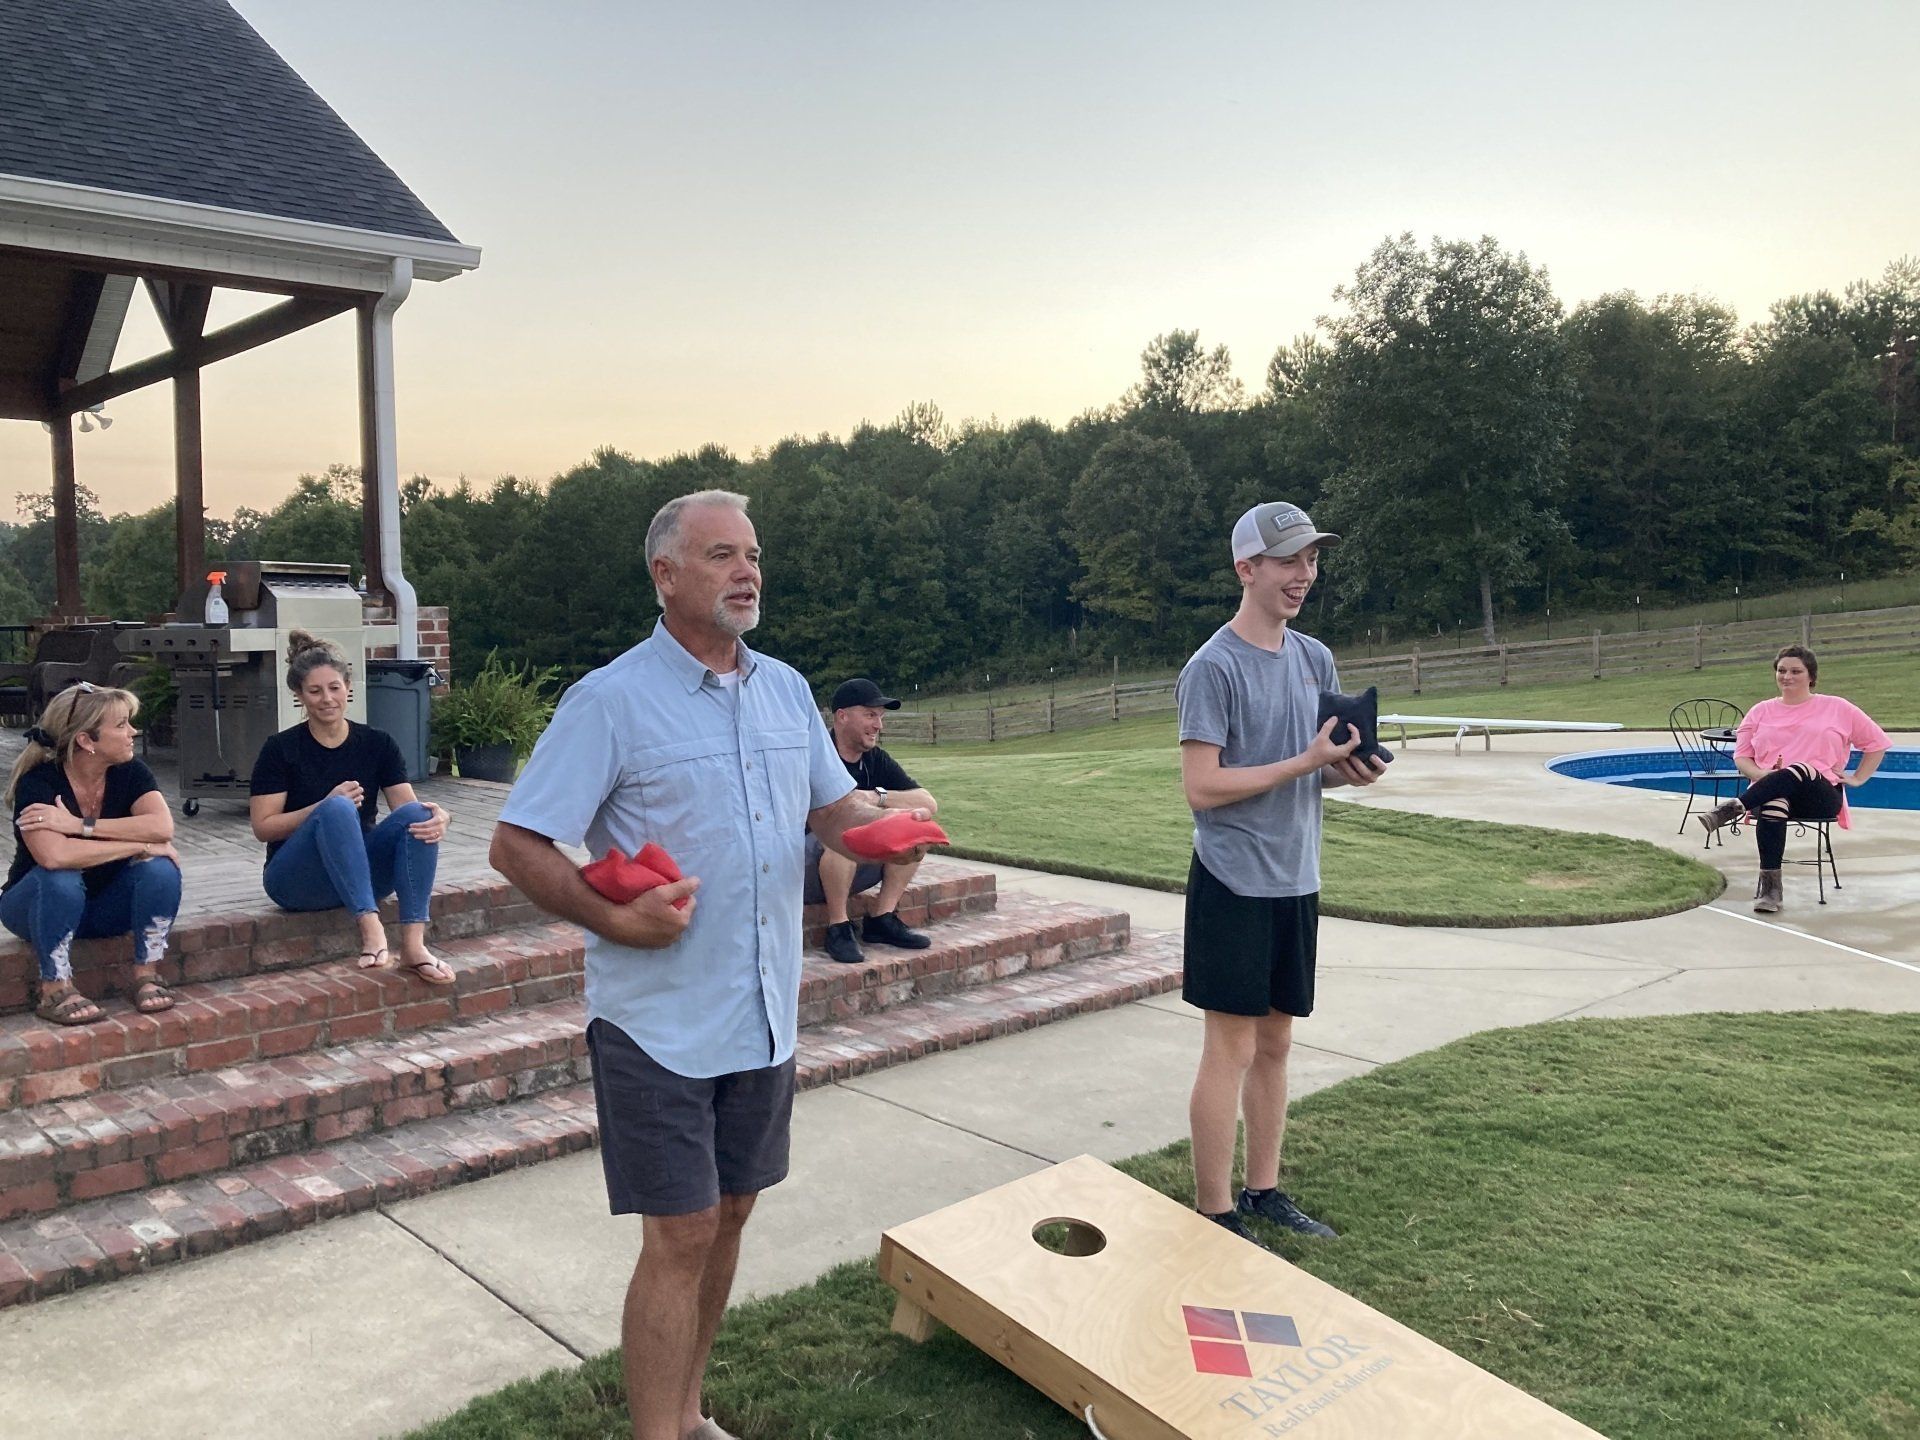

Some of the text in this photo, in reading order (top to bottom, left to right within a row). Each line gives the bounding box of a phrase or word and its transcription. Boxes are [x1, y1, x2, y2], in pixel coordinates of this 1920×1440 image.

[1219, 1334, 1371, 1420] TAYLOR
[1262, 1356, 1394, 1438] Real Estate Solutions
